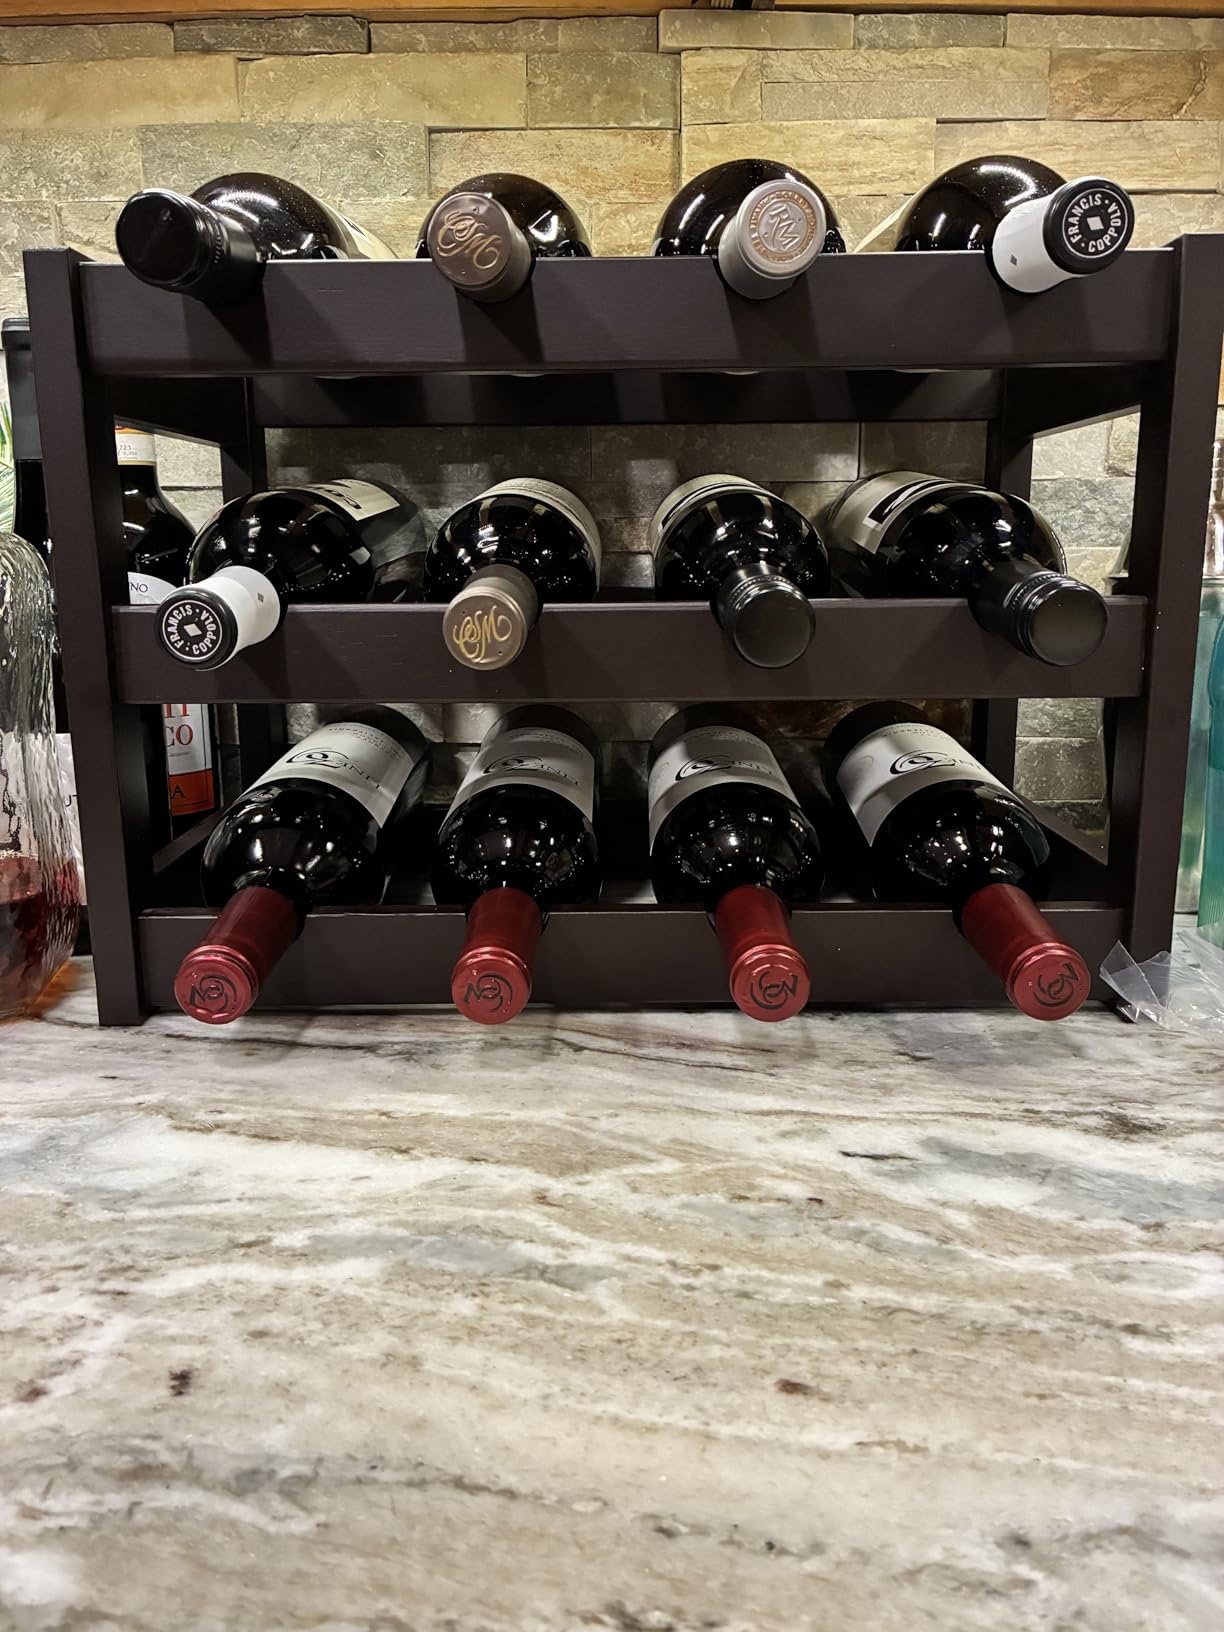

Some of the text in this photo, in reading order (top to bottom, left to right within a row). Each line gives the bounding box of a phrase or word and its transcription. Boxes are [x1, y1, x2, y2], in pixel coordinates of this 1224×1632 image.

[1067, 193, 1121, 252] FRANCIS COPPOLA
[167, 604, 217, 655] FRANCIS COPPOLA
